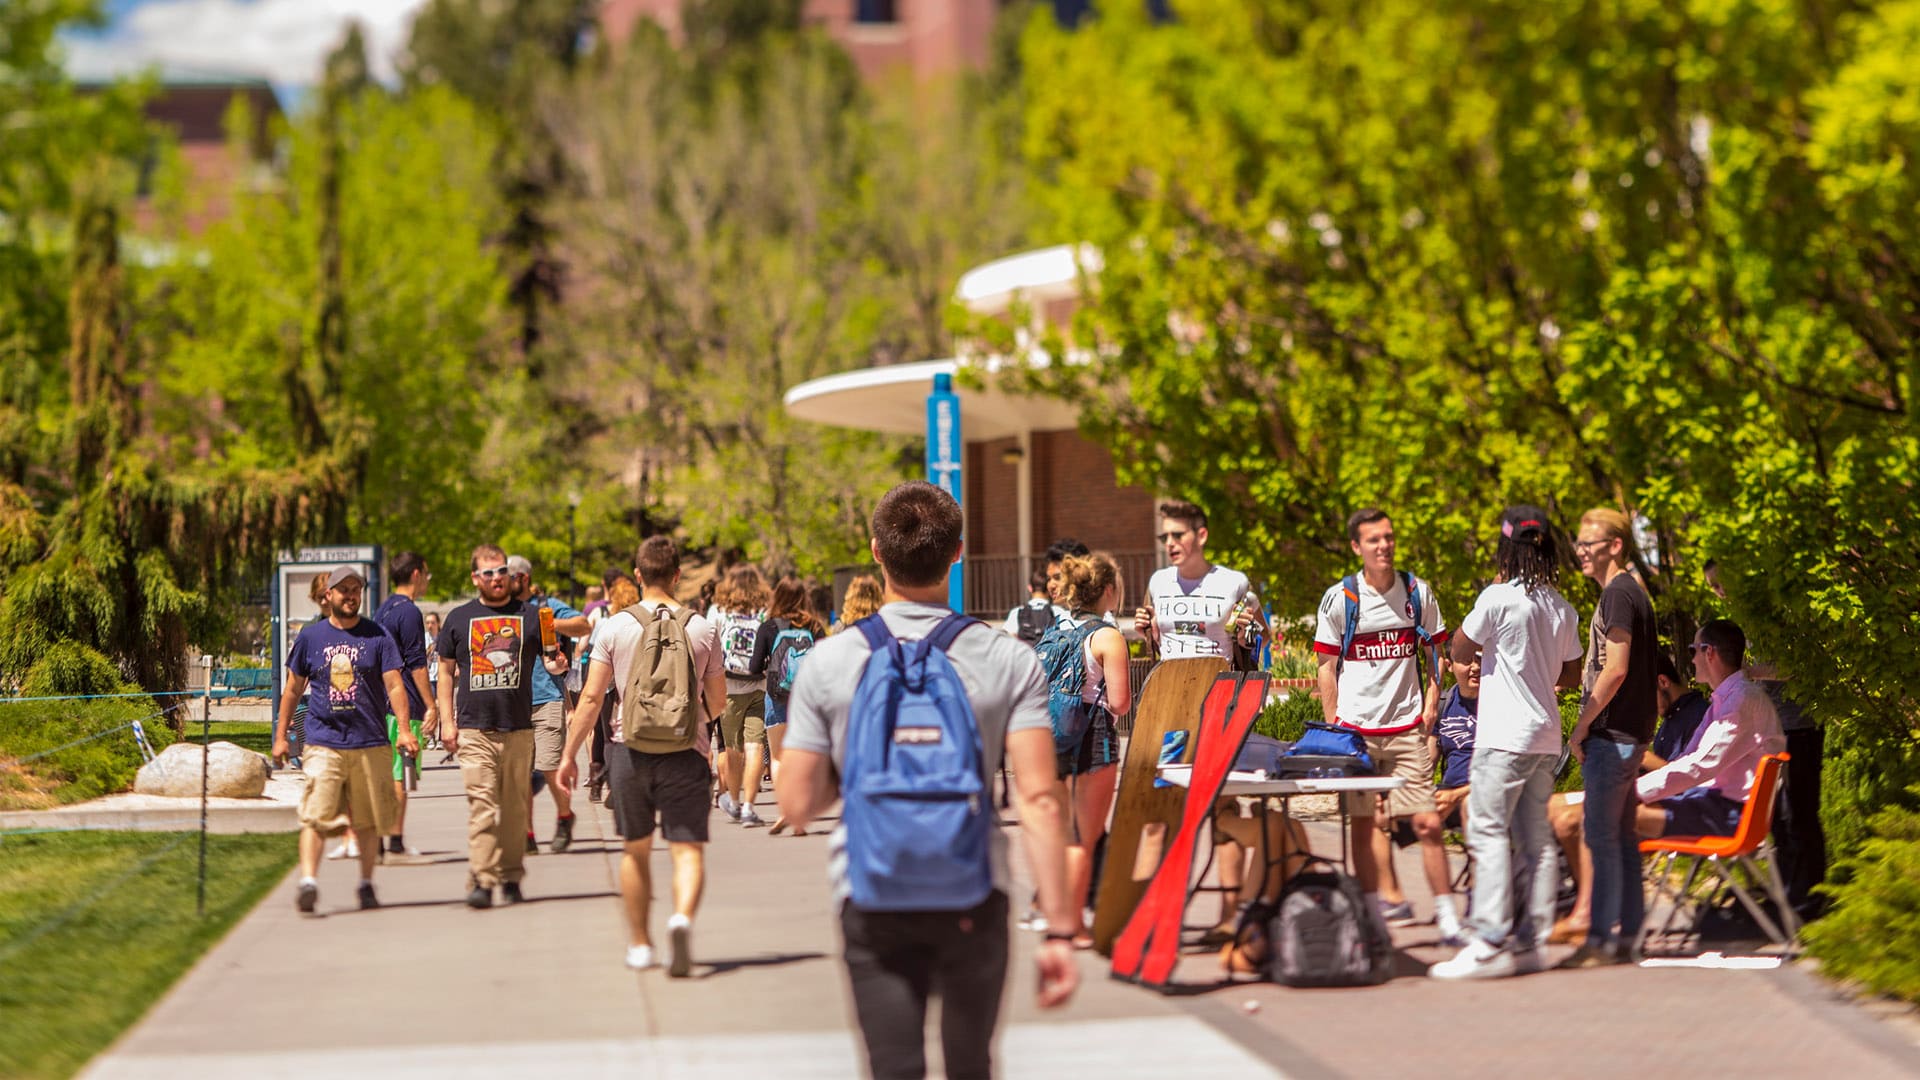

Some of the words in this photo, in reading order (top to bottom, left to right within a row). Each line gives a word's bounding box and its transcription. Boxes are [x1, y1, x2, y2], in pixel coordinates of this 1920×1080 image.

[1160, 602, 1221, 617] HOLLI
[1181, 623, 1199, 633] 22
[1378, 631, 1399, 643] Fly
[1166, 640, 1222, 655] STER
[1355, 641, 1414, 659] Emirate
[472, 672, 519, 689] OBEY
